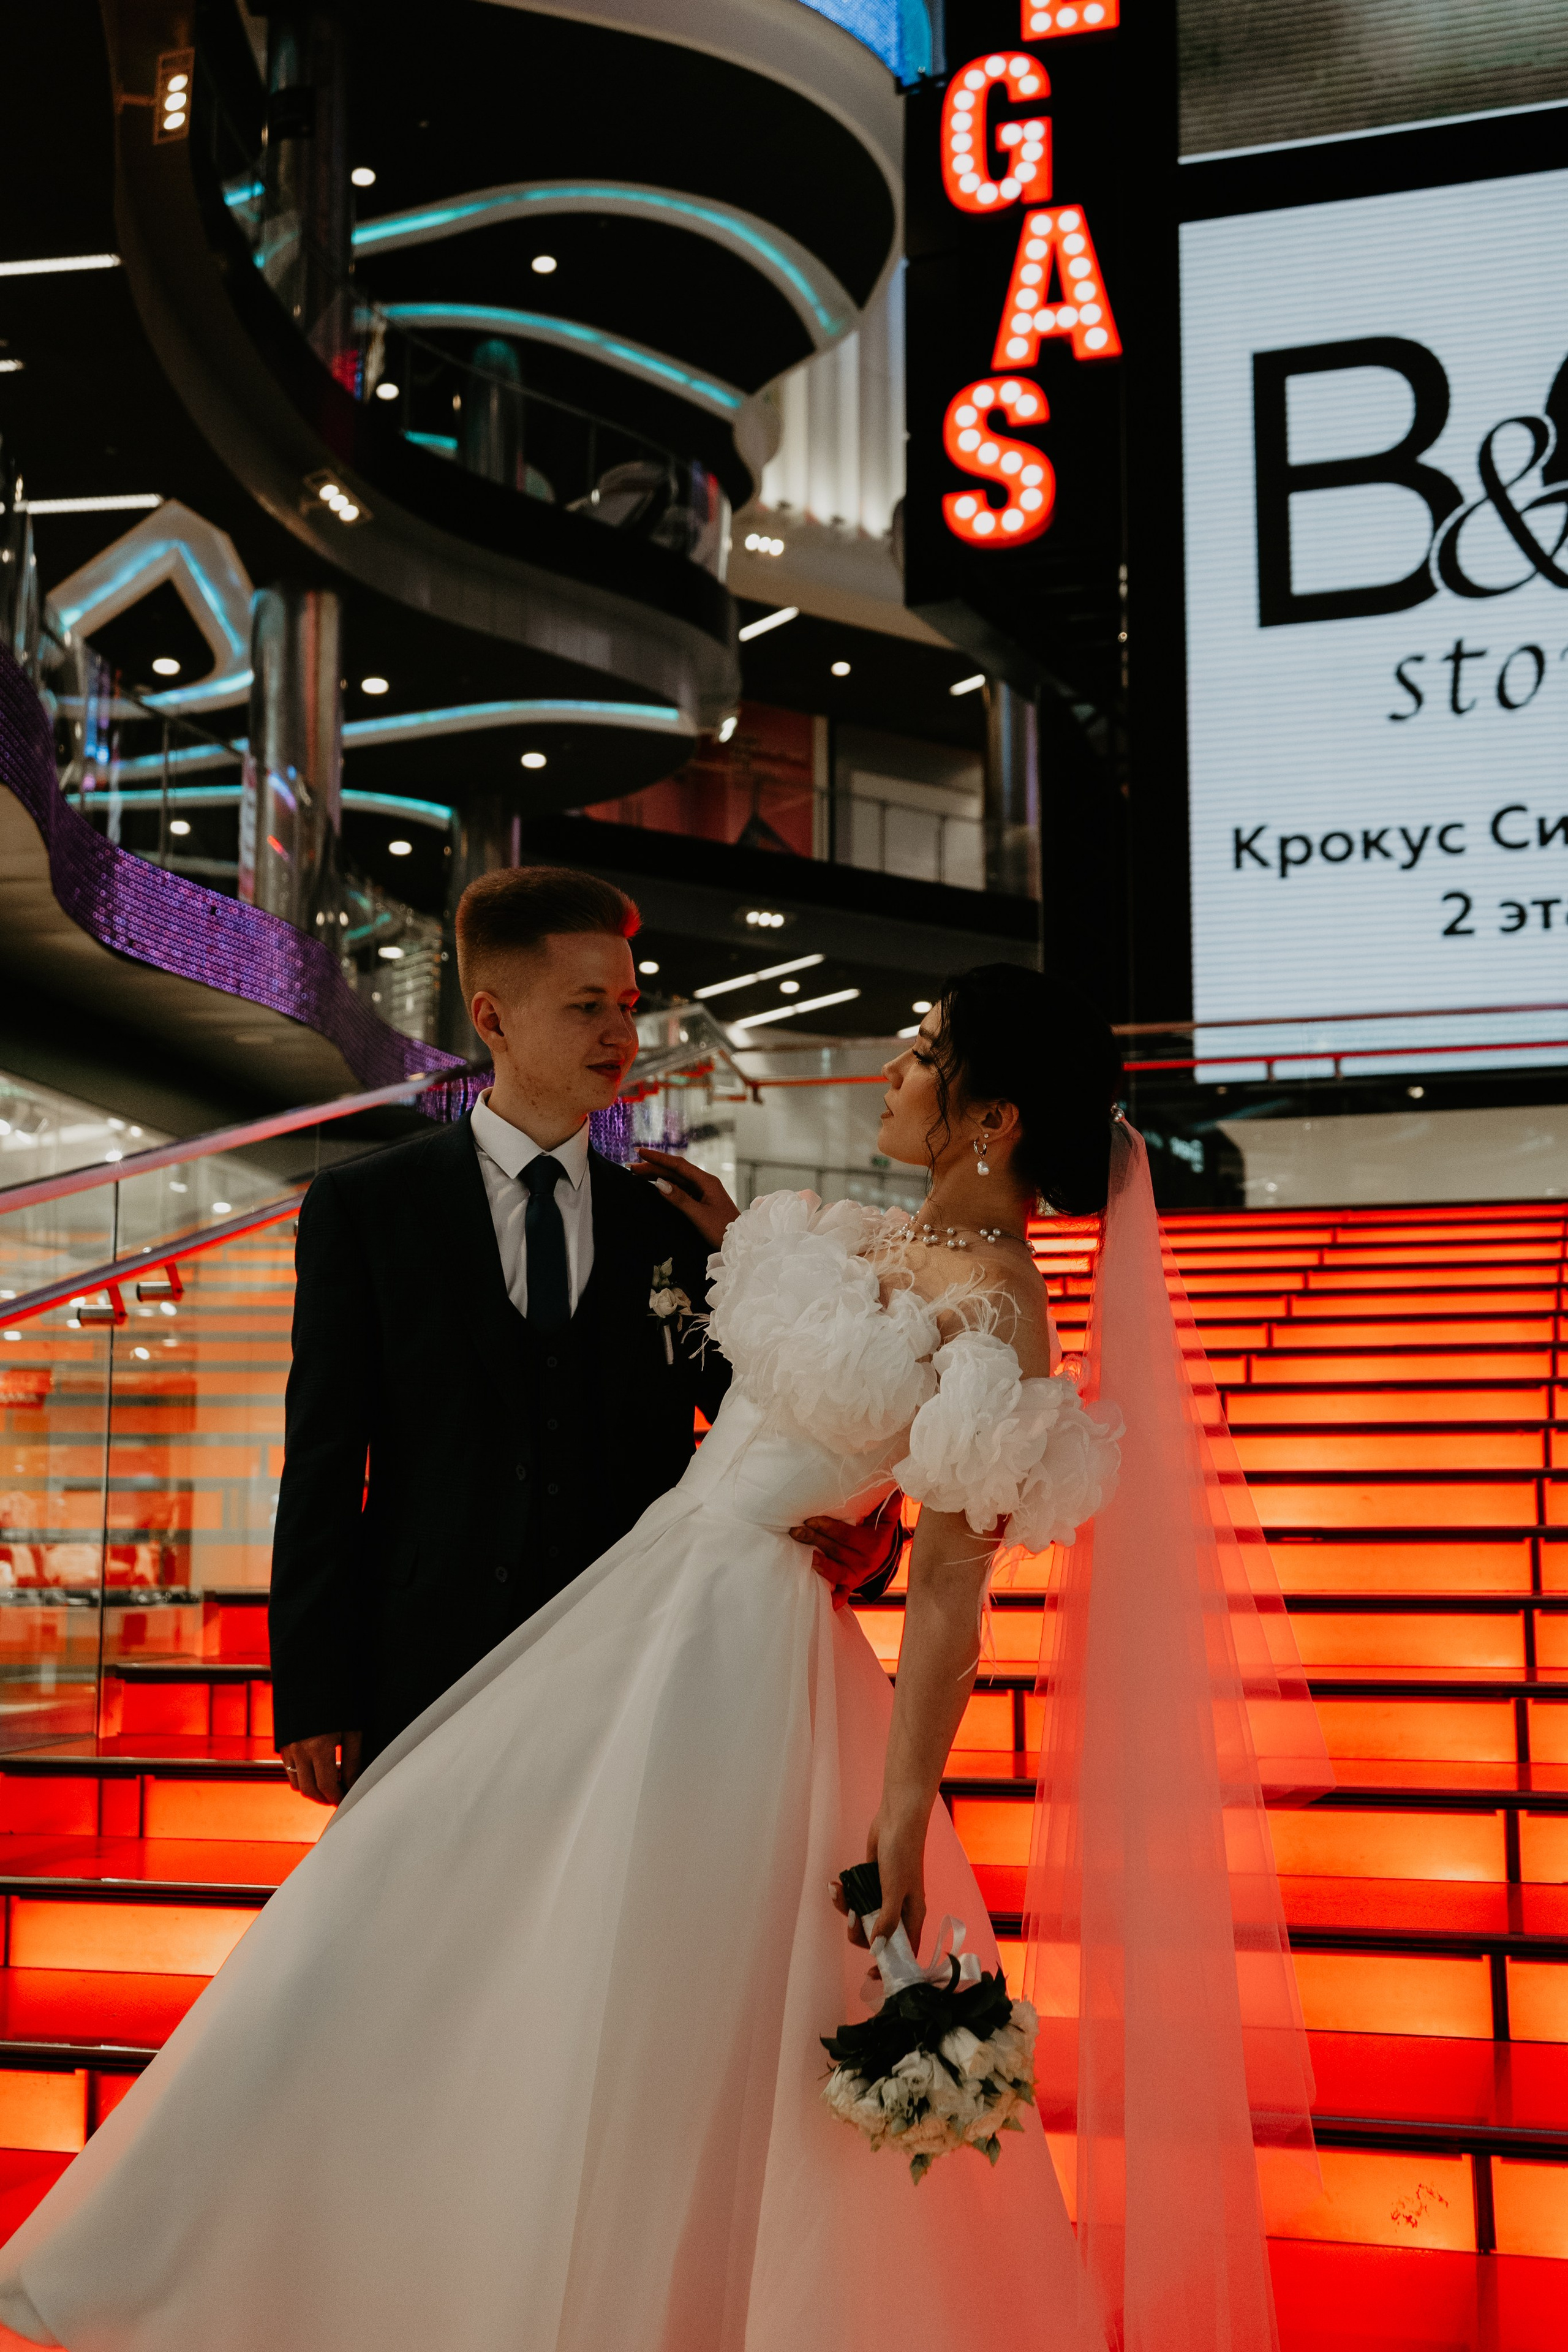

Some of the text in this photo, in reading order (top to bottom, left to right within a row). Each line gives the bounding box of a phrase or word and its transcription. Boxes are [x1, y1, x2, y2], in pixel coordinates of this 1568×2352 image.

[941, 0, 1122, 547] GAS
[1252, 336, 1568, 628] B&
[1389, 638, 1568, 722] sto
[1233, 822, 1466, 880] Крокус
[1441, 891, 1568, 937] 2 эт
